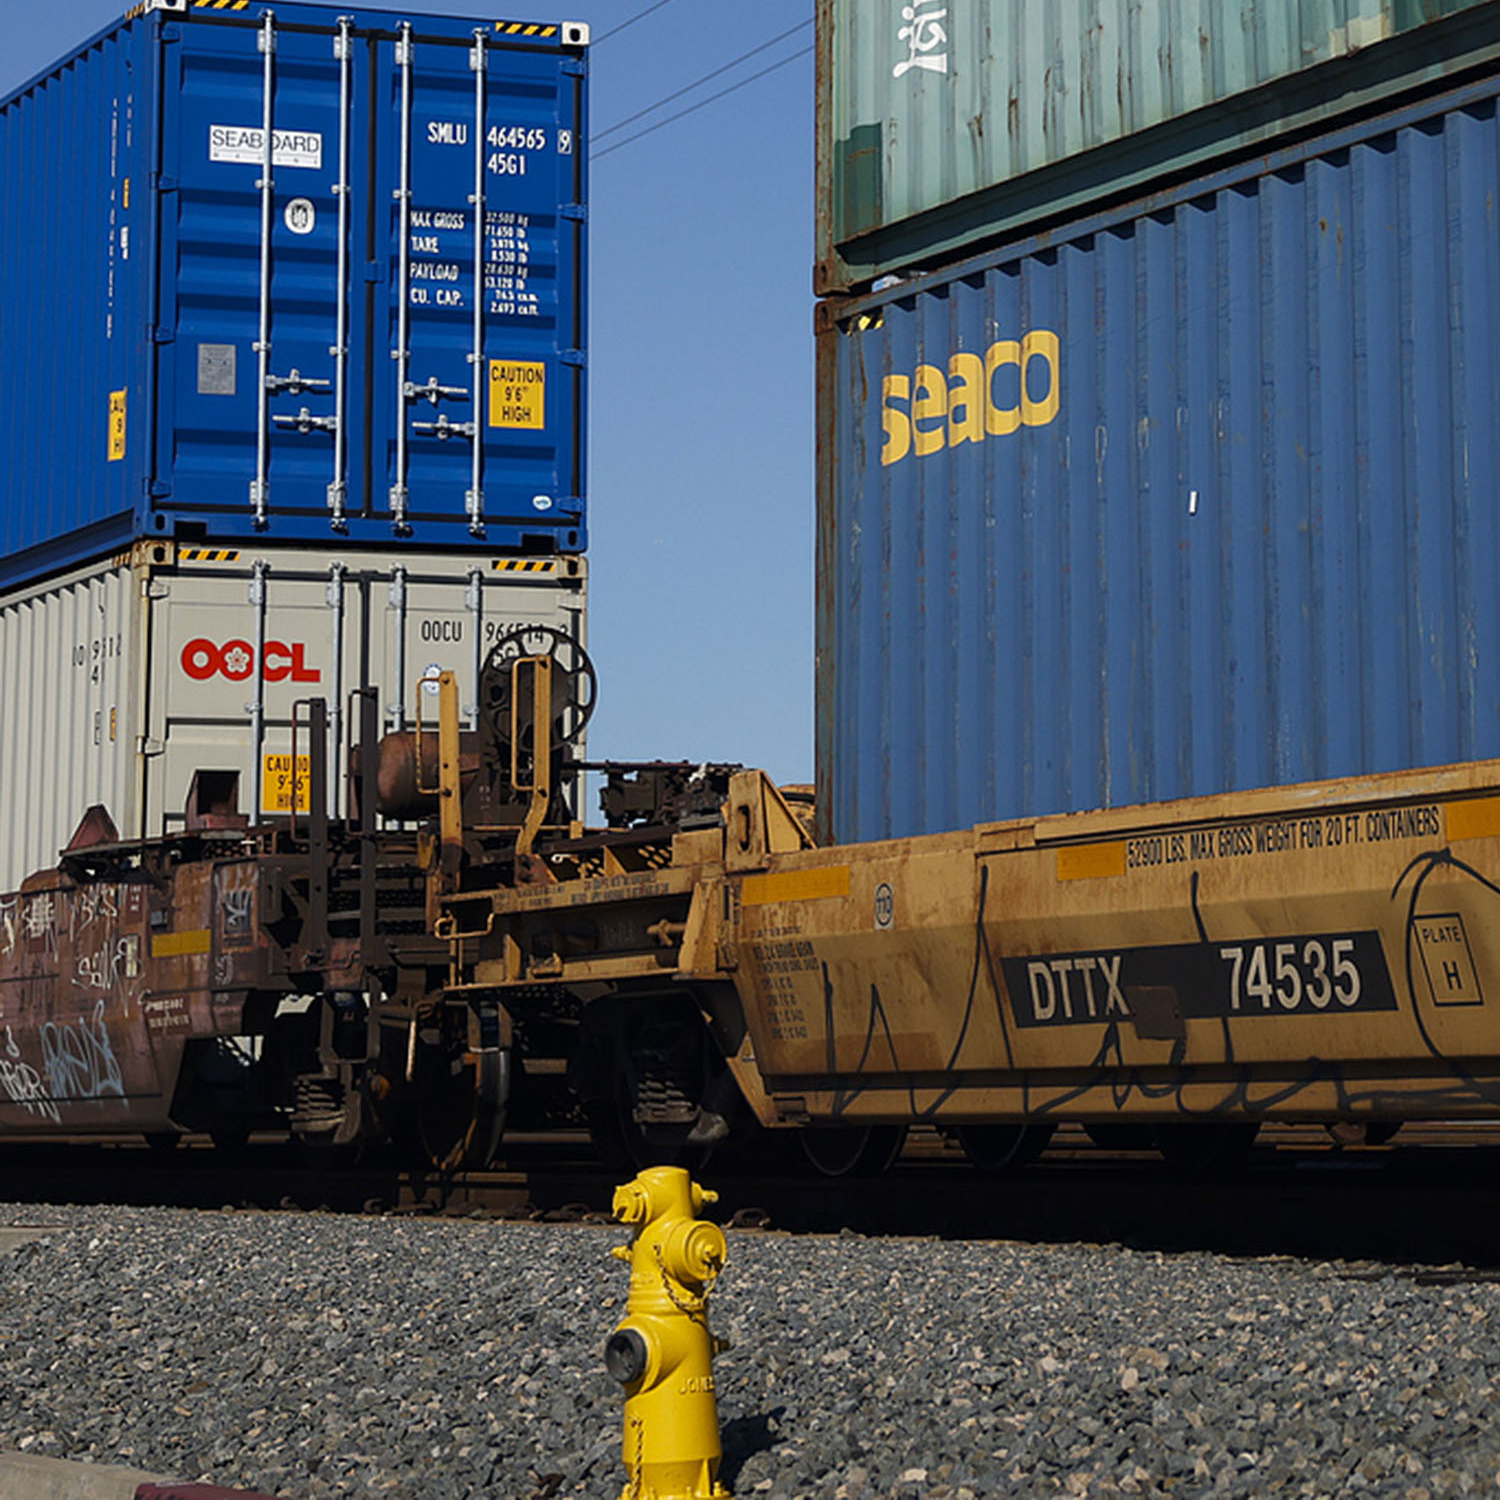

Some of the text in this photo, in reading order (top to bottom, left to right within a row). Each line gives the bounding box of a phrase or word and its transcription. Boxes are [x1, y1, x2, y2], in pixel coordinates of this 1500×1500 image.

[428, 121, 570, 152] SMLU 464565 9
[487, 153, 526, 176] 45G1
[410, 211, 465, 229] MAX GROSS
[411, 236, 439, 254] TARE
[410, 262, 460, 282] PAYLOAD
[491, 366, 544, 384] CAUTION
[881, 330, 1060, 466] seaco
[502, 405, 532, 422] HIGH
[421, 619, 463, 642] OOCU
[181, 638, 321, 682] OOCL
[1128, 838, 1161, 869] 52900
[1165, 835, 1188, 863] LBS.
[1190, 832, 1216, 861] MAX
[1218, 827, 1253, 858] GROSS
[1255, 821, 1297, 853] WEIGHT
[1300, 819, 1322, 850] FOR
[1326, 816, 1342, 847] 20
[1366, 806, 1440, 843] CONTAINERS
[1422, 925, 1462, 943] PLATE
[1027, 939, 1362, 1020] DTTX 74535
[1442, 961, 1462, 990] H
